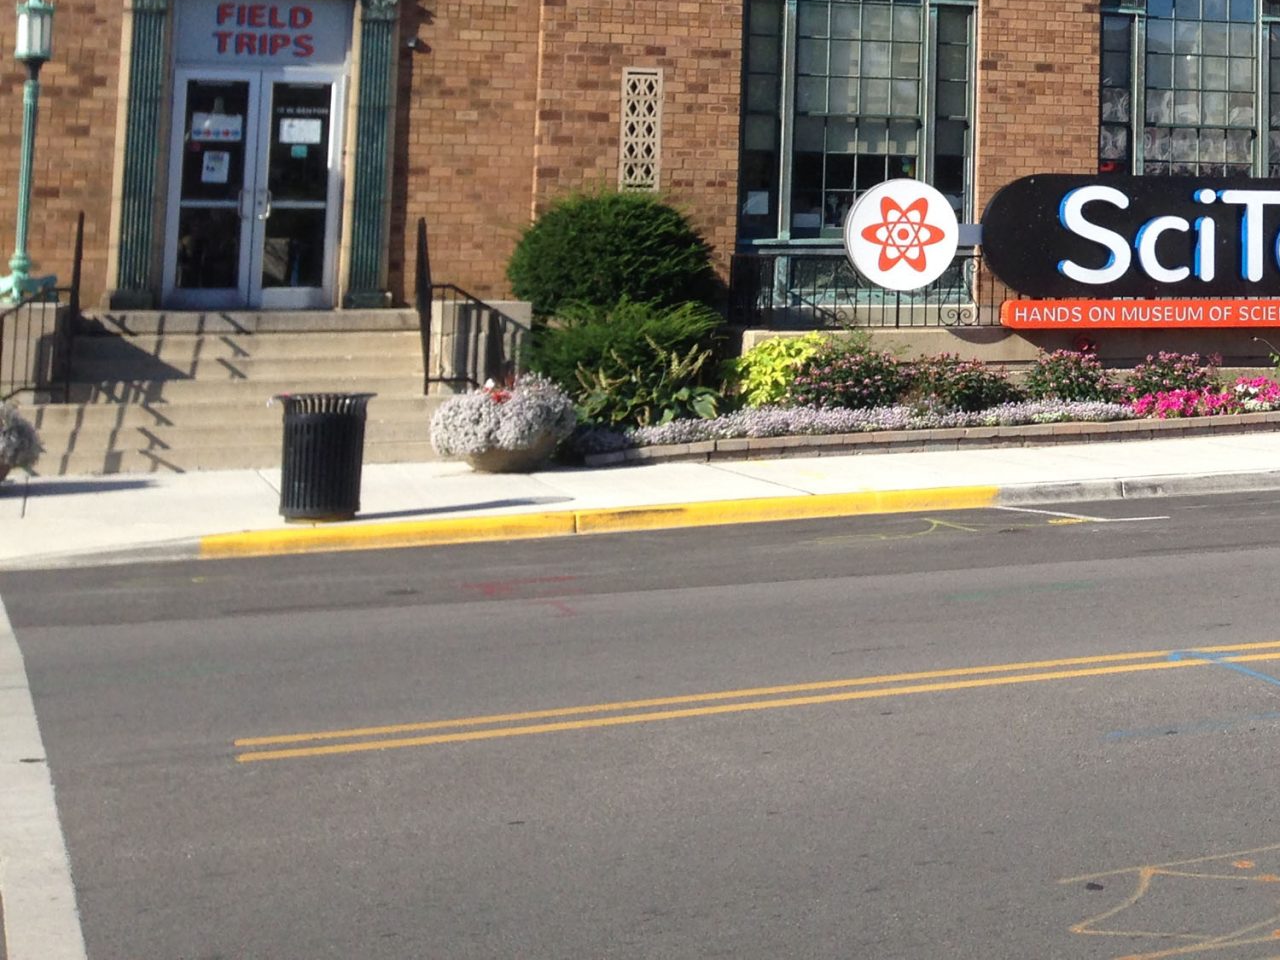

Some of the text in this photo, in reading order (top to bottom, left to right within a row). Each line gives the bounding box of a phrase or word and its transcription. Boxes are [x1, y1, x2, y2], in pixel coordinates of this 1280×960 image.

[216, 2, 313, 29] FIELD
[213, 31, 314, 58] TRIPS
[1014, 306, 1082, 322] HANDS
[1088, 306, 1116, 322] ON
[1121, 306, 1203, 322] MUSEUM
[1209, 305, 1232, 321] OF
